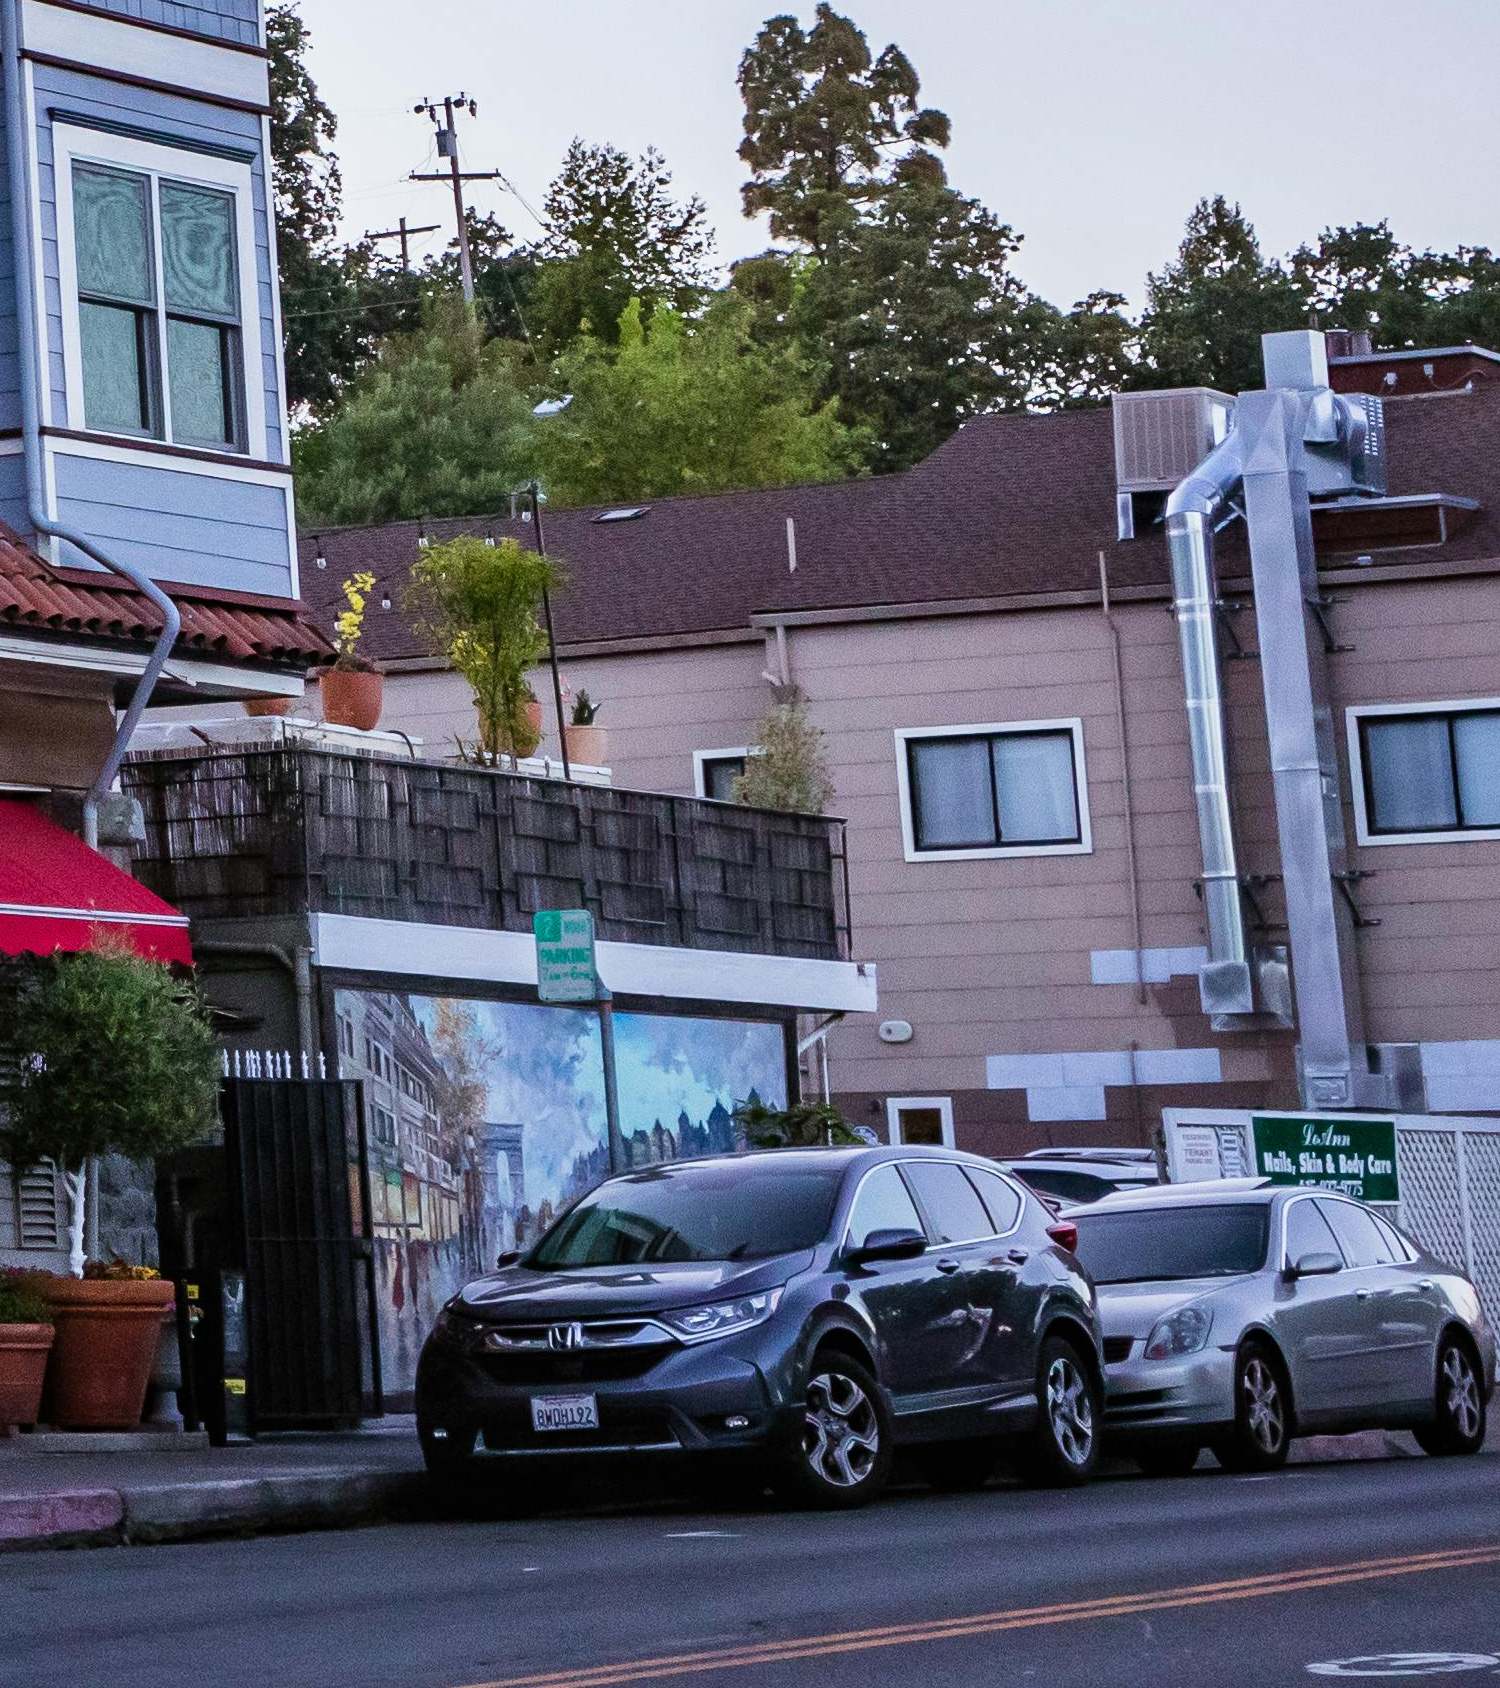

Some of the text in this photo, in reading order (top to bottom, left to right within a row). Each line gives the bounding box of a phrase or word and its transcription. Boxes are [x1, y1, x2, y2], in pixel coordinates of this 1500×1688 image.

[540, 947, 592, 965] PARKING
[1263, 1151, 1296, 1175] Nails,
[1299, 1151, 1323, 1174] Skin
[1326, 1154, 1336, 1174] &
[1339, 1153, 1365, 1178] Body
[1368, 1154, 1392, 1174] Care
